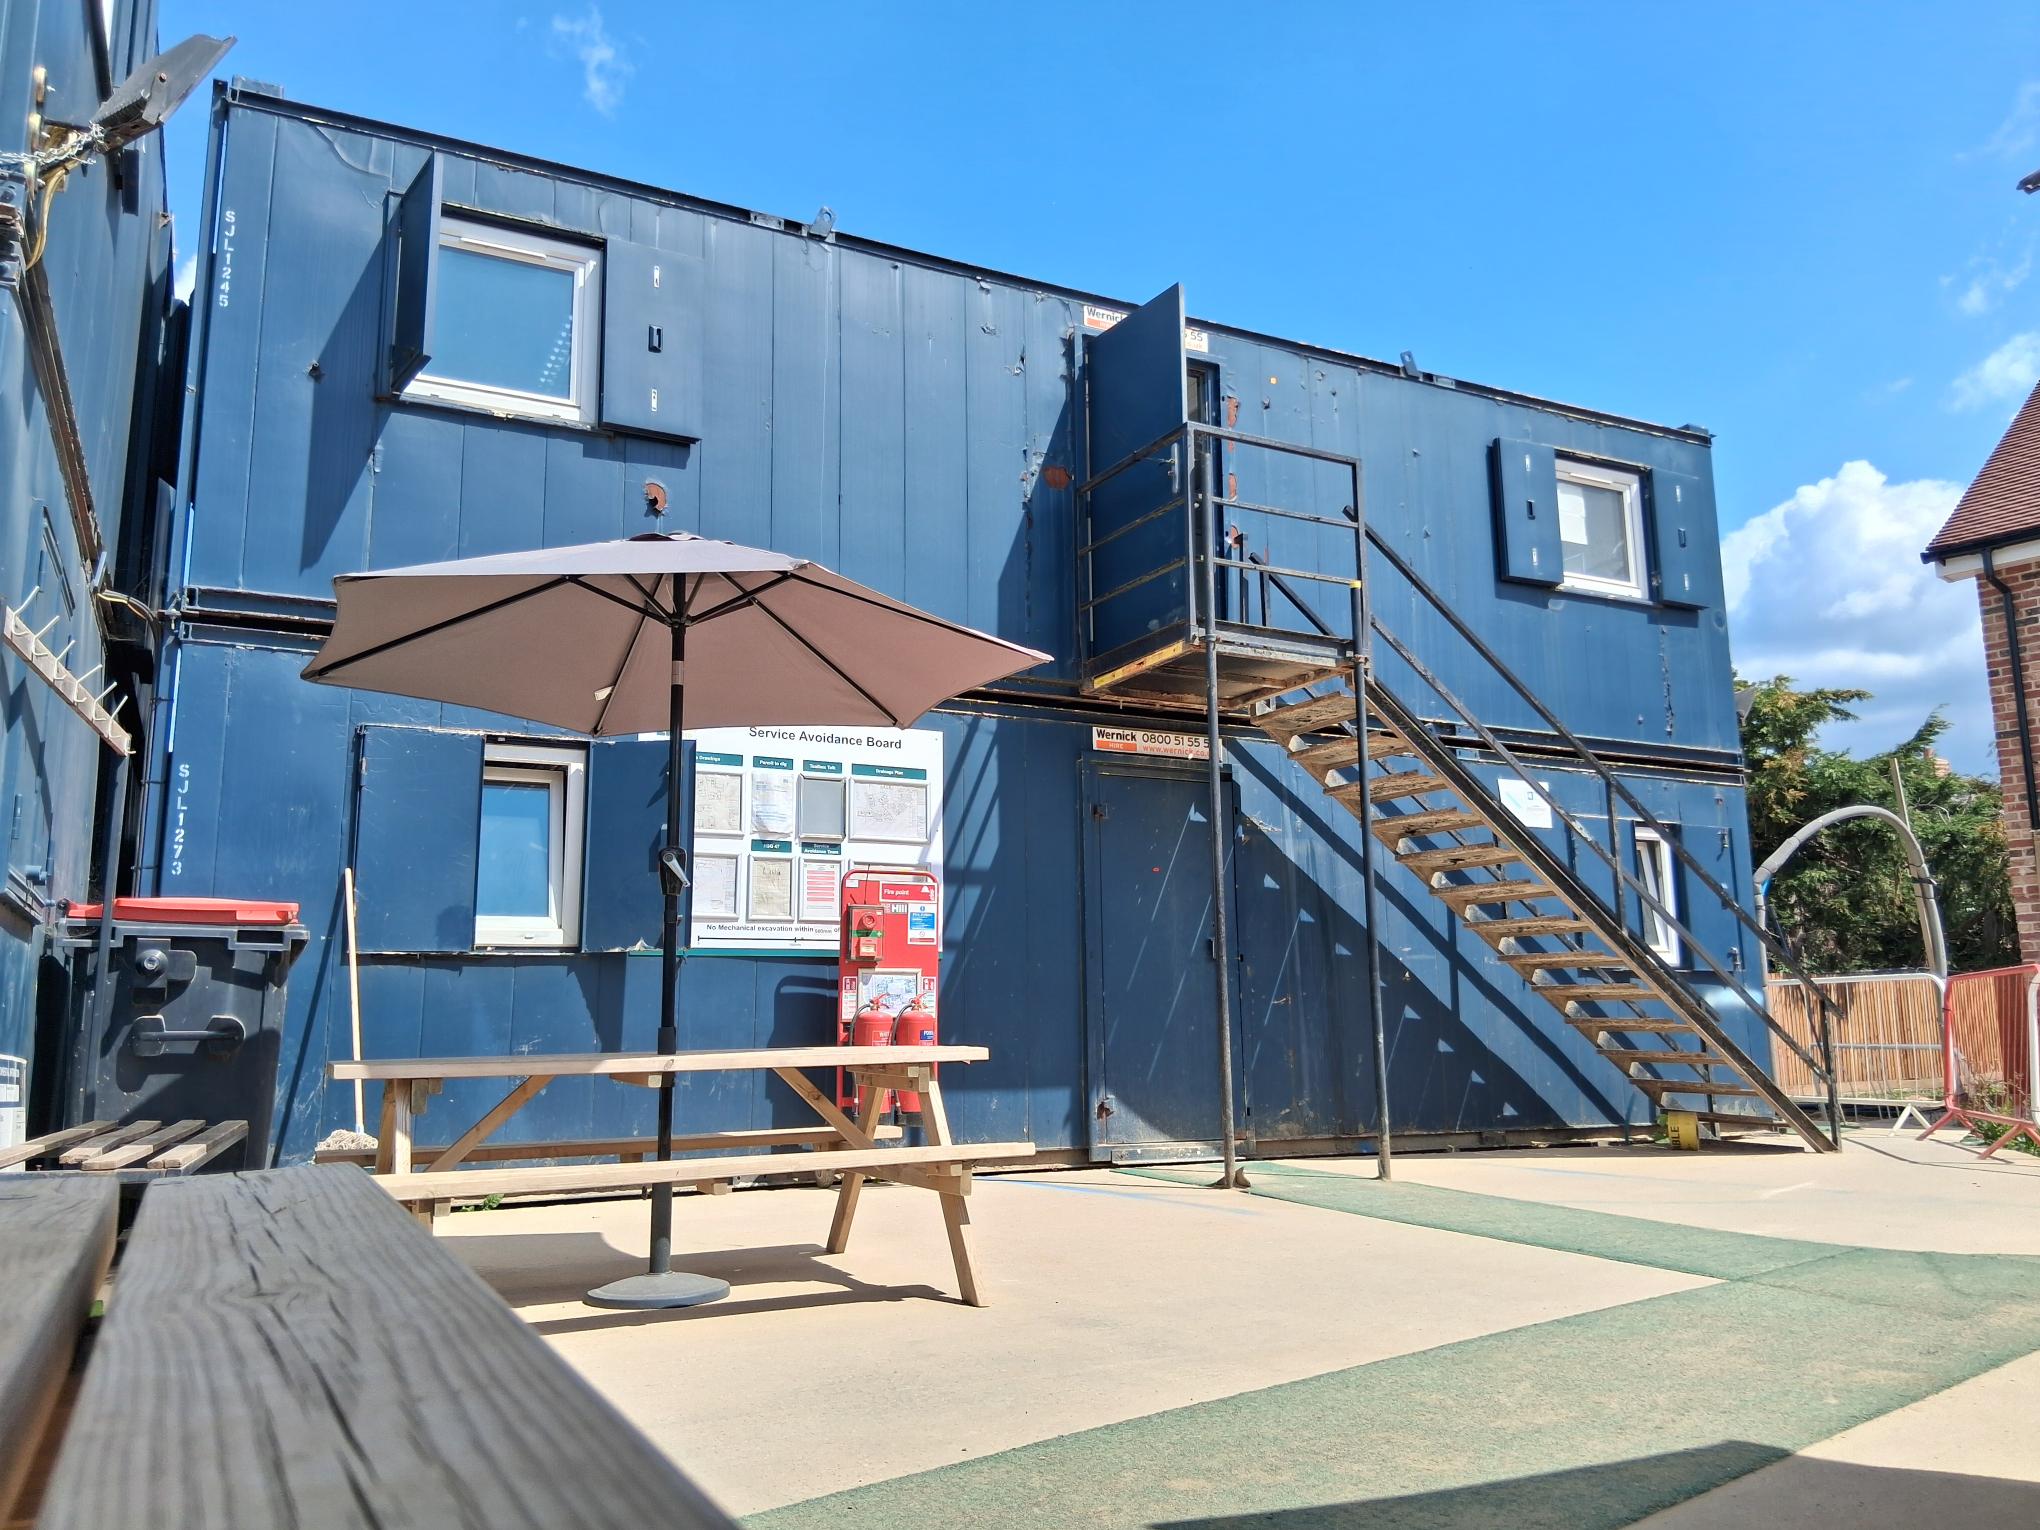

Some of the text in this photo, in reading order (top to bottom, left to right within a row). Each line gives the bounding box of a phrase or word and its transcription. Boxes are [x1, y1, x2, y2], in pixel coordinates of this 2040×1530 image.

[219, 210, 236, 307] SJL1245
[749, 727, 902, 749] Service Avoidance Board
[1096, 729, 1137, 741] Wernick
[1142, 733, 1171, 745] 0800
[1174, 735, 1185, 746] 51
[1187, 737, 1201, 748] 55
[171, 763, 190, 876] SJL1273
[891, 903, 908, 913] Hill
[718, 924, 756, 932] Mechanical
